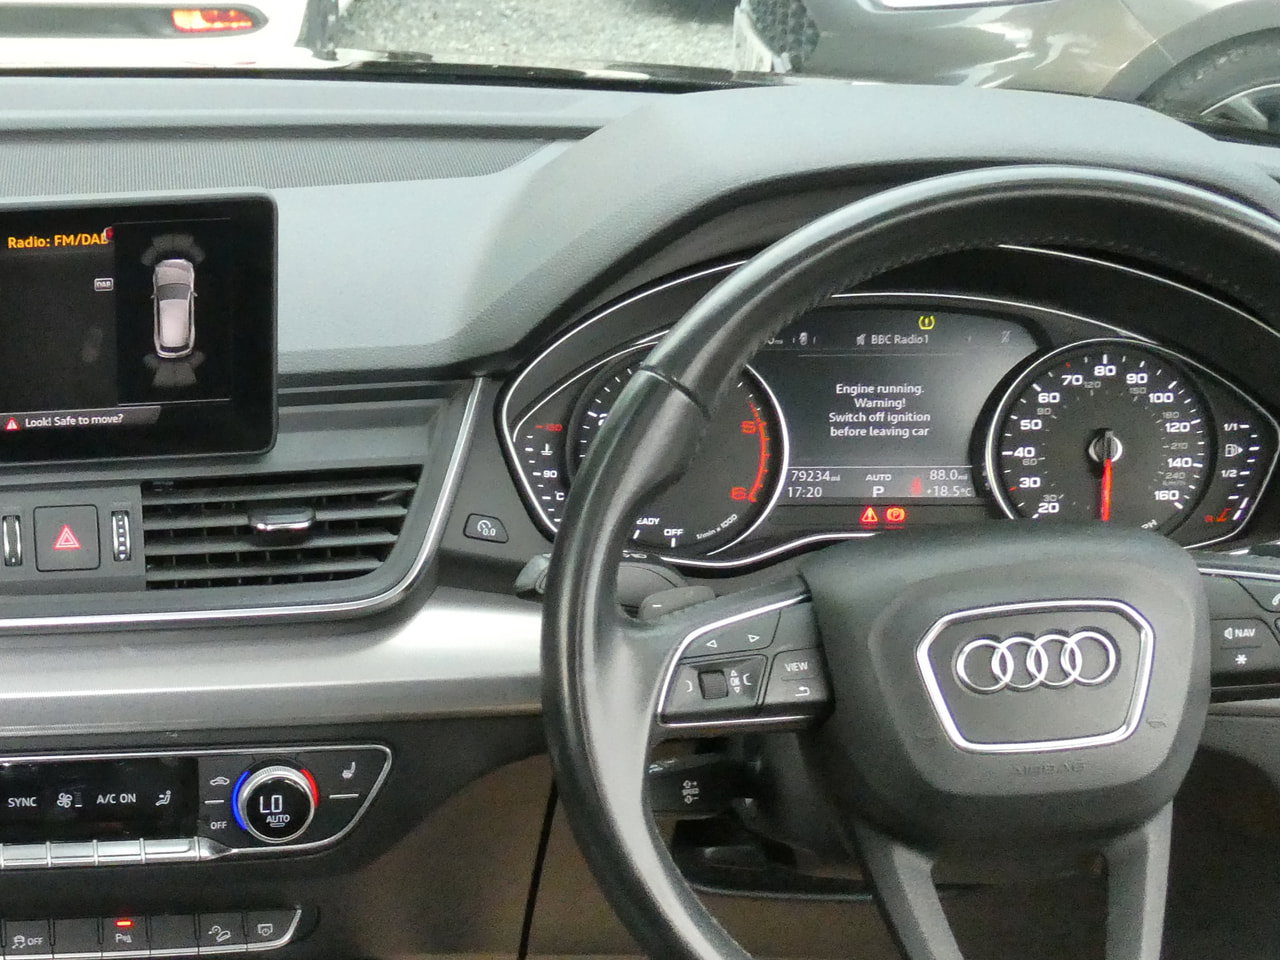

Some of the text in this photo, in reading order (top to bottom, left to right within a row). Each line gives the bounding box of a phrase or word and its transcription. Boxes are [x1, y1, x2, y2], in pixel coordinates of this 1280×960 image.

[7, 236, 51, 249] Radio:
[871, 334, 892, 344] BBC
[1094, 365, 1117, 376] 80
[1061, 374, 1083, 386] 70
[1126, 373, 1148, 384] 90
[835, 384, 925, 396] Engine running.
[1038, 392, 1060, 404] 60
[1148, 392, 1174, 403] 100
[854, 398, 906, 410] Warning!
[25, 413, 124, 428] Look! Safe to move?
[829, 411, 931, 424] Switch off ignition
[1020, 419, 1042, 430] 50
[1165, 421, 1191, 432] 120
[1223, 423, 1238, 431] 1/1
[830, 426, 929, 438] before leaving car
[1014, 446, 1035, 457] 40
[1167, 457, 1192, 468] 140
[543, 470, 558, 478] 90
[865, 473, 892, 481] AUTO
[1221, 469, 1237, 477] 1/2
[1019, 477, 1041, 488] 30
[787, 486, 823, 498] 17:20
[872, 486, 885, 497] P
[1154, 490, 1179, 500] 160
[1038, 502, 1060, 513] 20
[1234, 628, 1256, 638] NAV
[784, 662, 808, 672] VIEW
[8, 796, 37, 808] SYNC
[96, 793, 136, 804] A/C ON
[266, 814, 291, 823] AUTO
[210, 821, 227, 830] OFF
[27, 937, 44, 946] OFF
